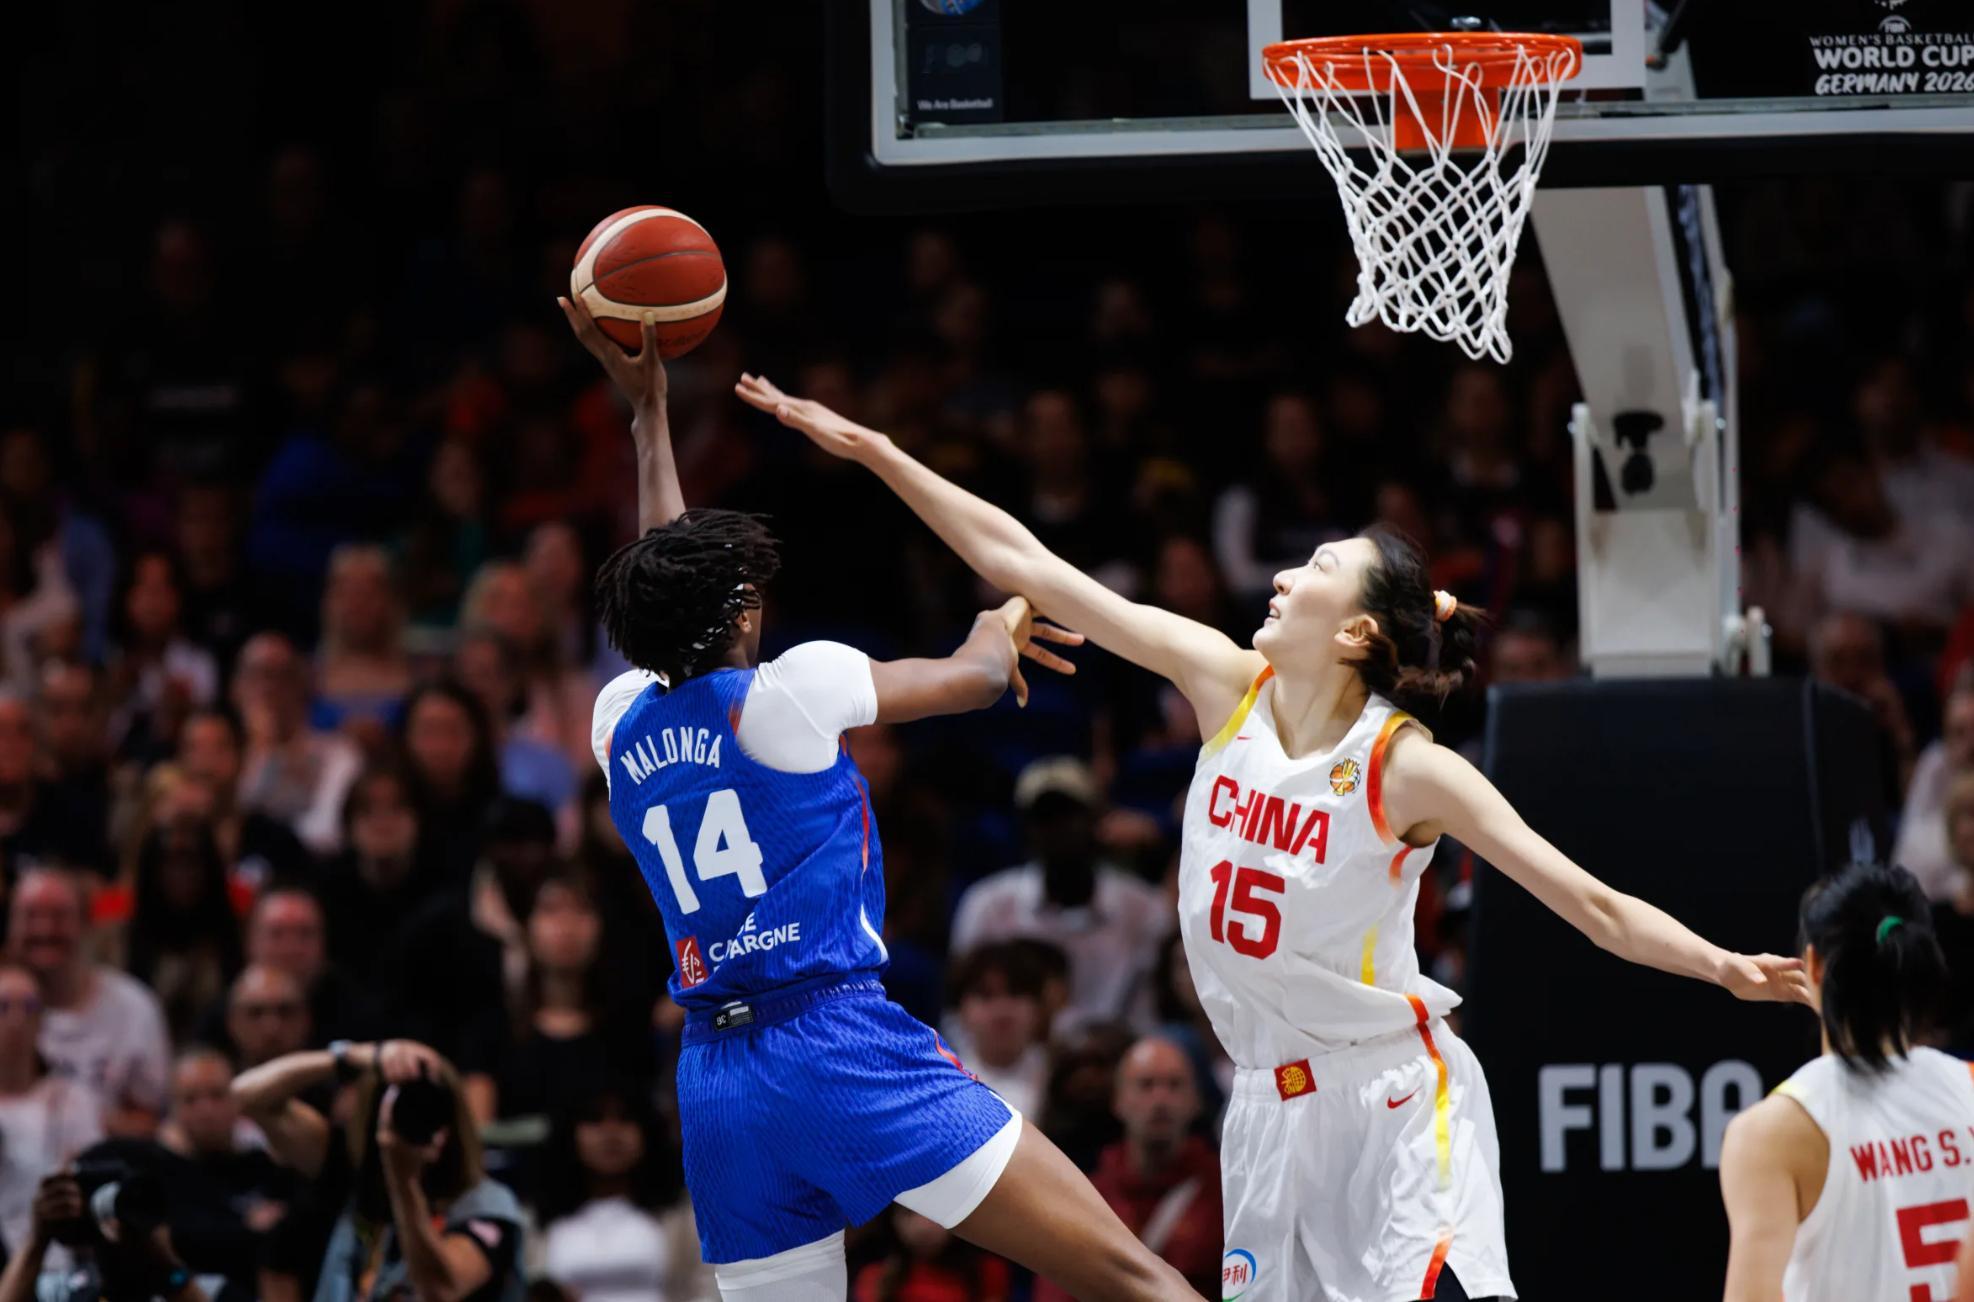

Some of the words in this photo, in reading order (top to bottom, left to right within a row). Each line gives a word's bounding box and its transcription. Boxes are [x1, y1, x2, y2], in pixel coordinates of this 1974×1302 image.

[1809, 34, 1882, 47] WOMEN'S
[1885, 33, 1974, 45] BASKETBAL
[1813, 46, 1916, 70] WORLD
[1921, 45, 1974, 67] CUP
[1814, 72, 1920, 95] GERMANY
[1924, 71, 1974, 92] 2026
[620, 726, 723, 786] MALONGA
[642, 788, 768, 915] 14
[1208, 774, 1330, 865] CHINA
[1210, 859, 1285, 960] 15
[1538, 1059, 1764, 1173] FIBA
[1849, 1134, 1934, 1183] WANG
[1896, 1197, 1970, 1302] 5
